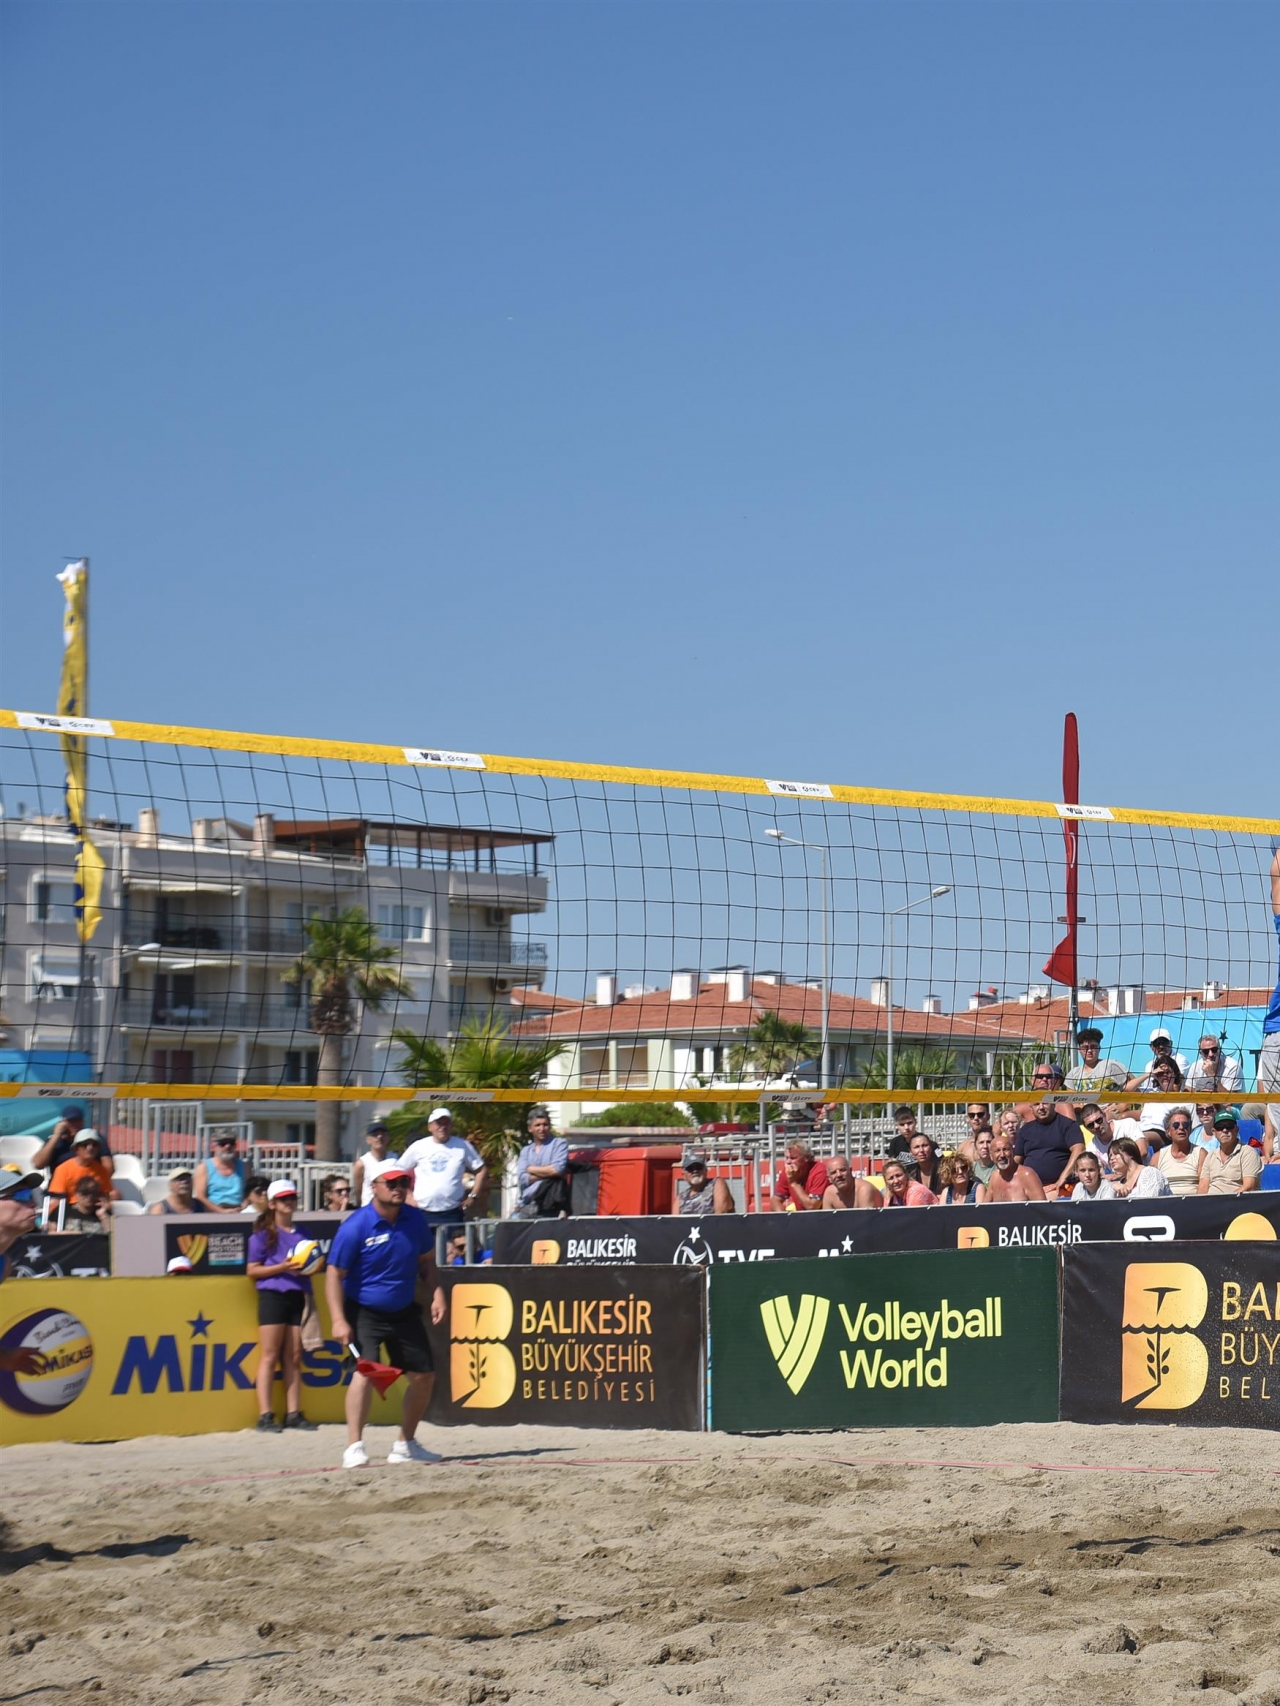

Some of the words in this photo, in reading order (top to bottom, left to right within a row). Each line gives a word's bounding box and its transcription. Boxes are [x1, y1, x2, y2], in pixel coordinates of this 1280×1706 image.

[567, 1234, 637, 1258] BALIKESİR
[998, 1219, 1082, 1247] BALIKESİR
[521, 1293, 653, 1335] BALIKESİR
[838, 1297, 1002, 1351] Volleyball
[522, 1339, 653, 1378] BÜYÜKŞEHİR
[839, 1347, 948, 1390] World
[523, 1376, 655, 1402] BELEDİYESİ
